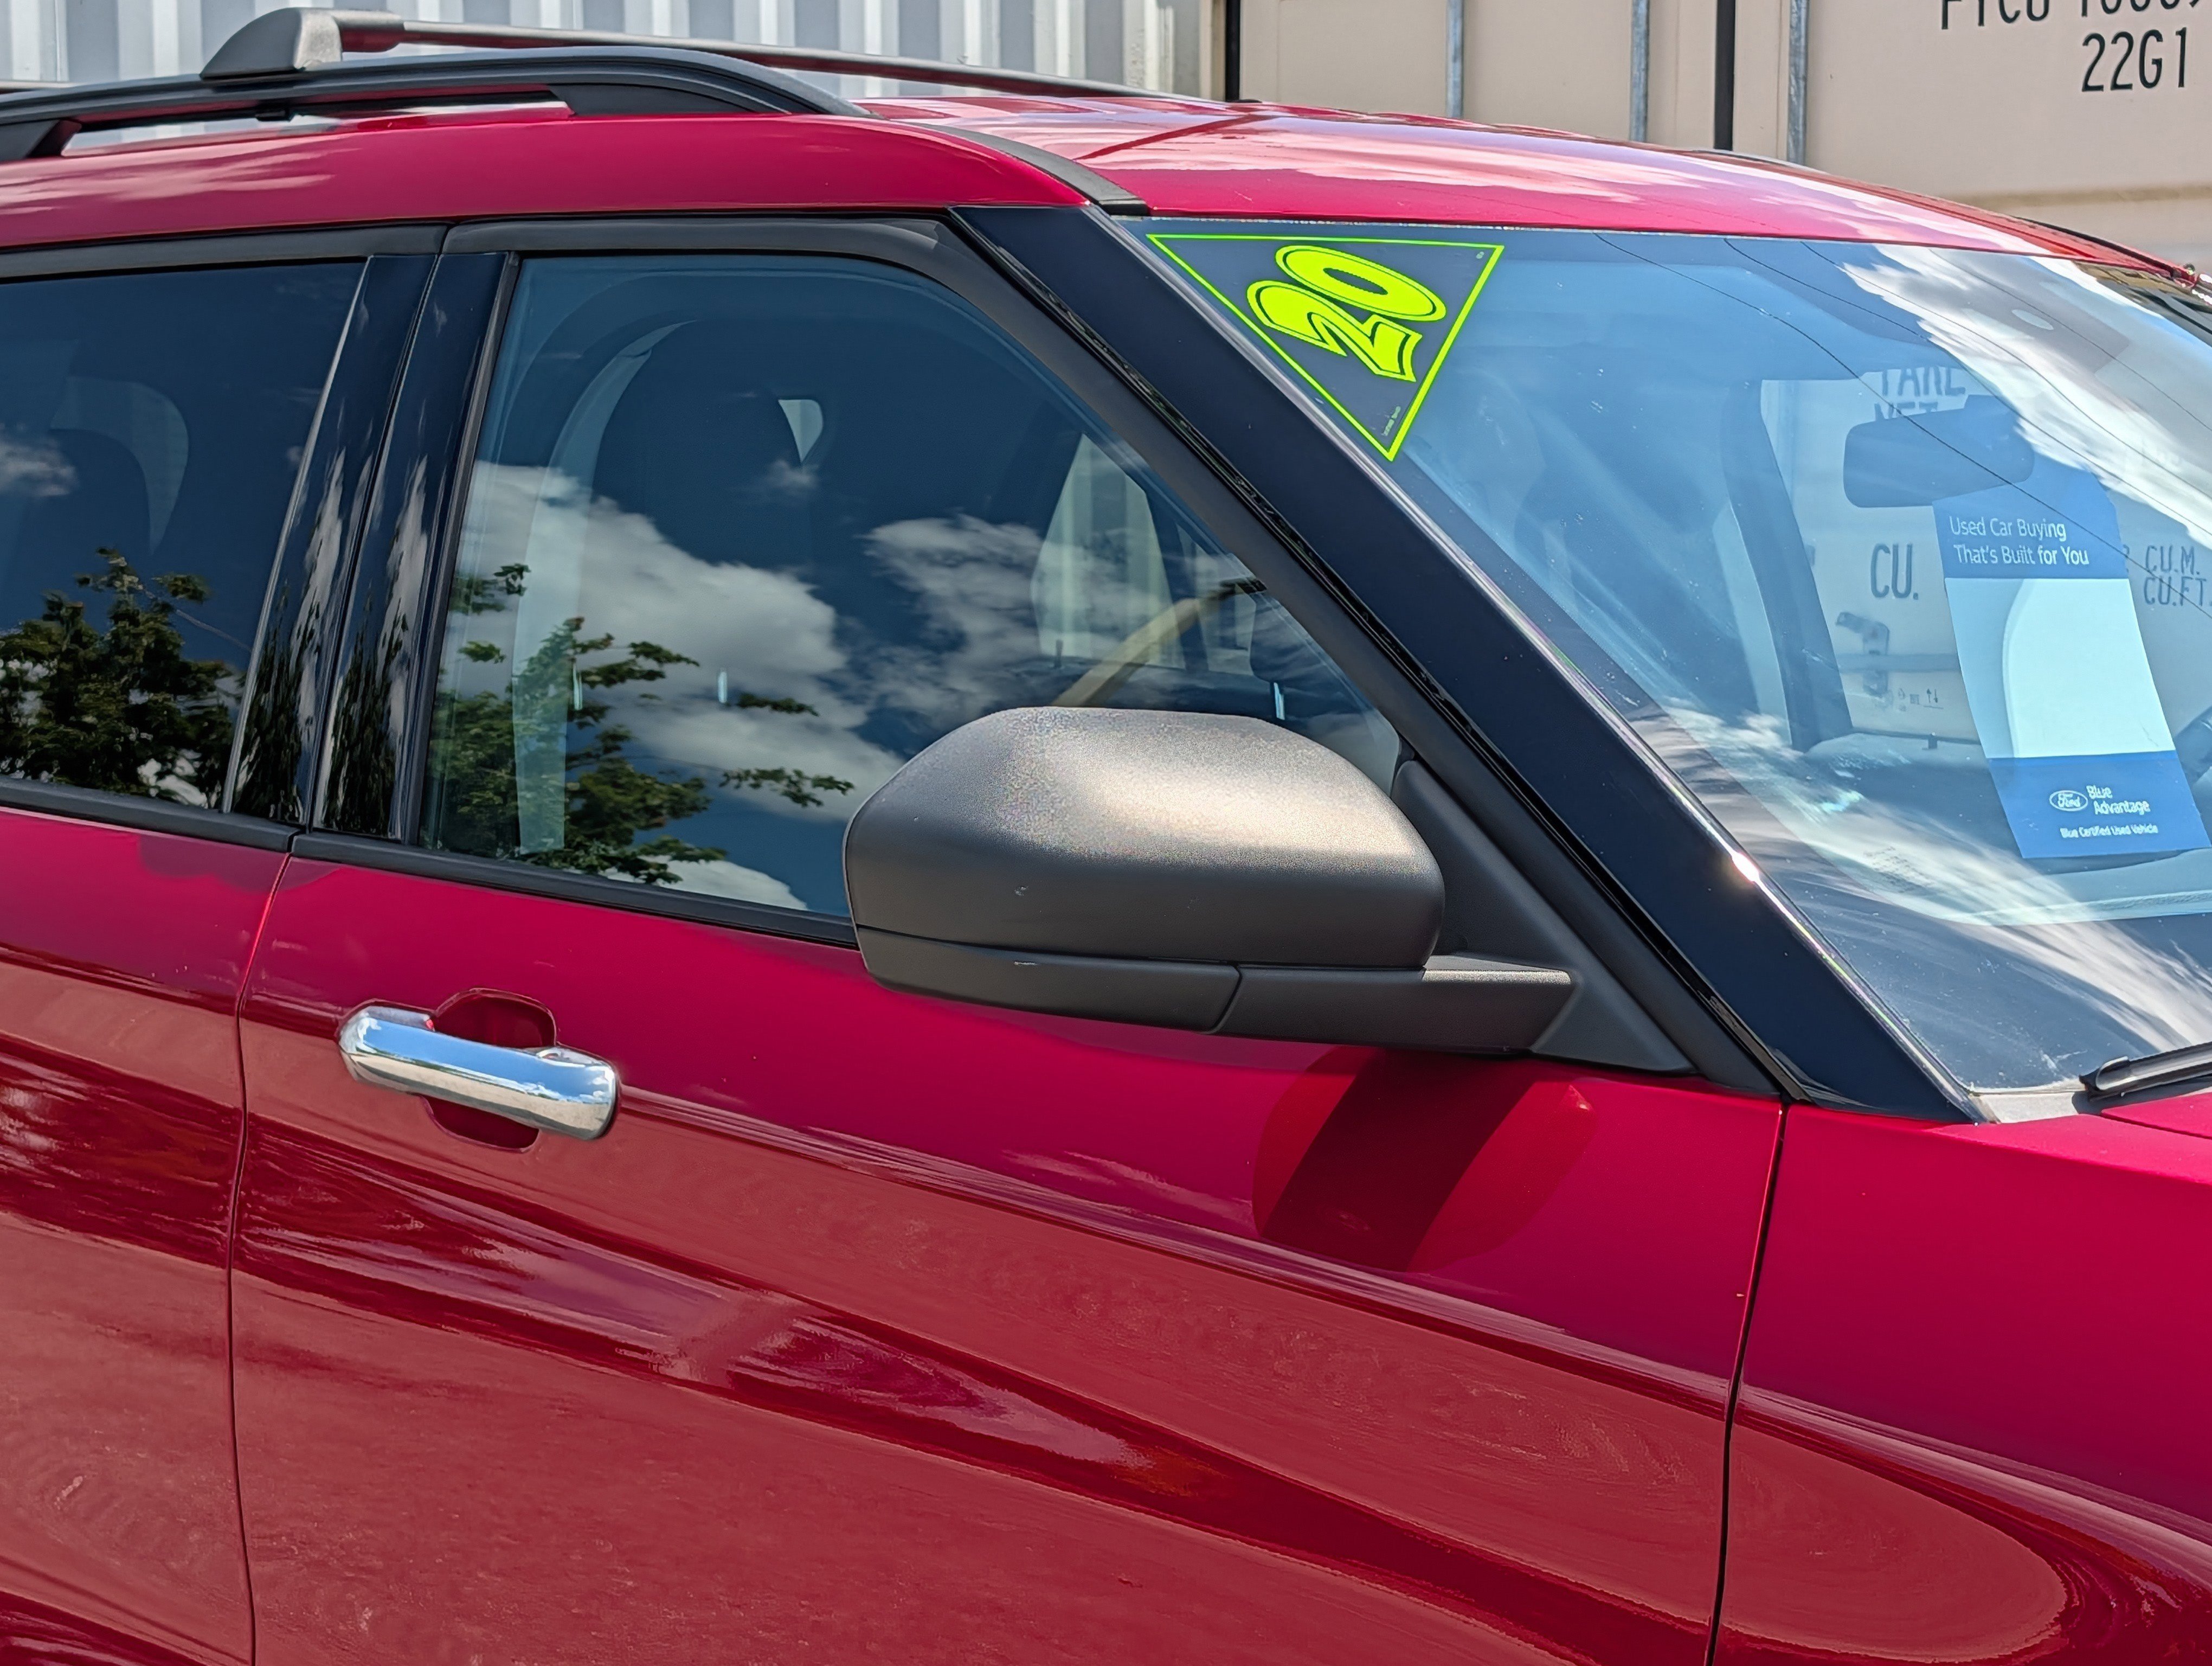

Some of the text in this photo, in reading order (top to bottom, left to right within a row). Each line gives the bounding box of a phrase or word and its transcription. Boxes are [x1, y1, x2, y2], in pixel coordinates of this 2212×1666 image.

[2081, 27, 2188, 92] 22G1
[1246, 245, 1446, 382] 20
[1949, 516, 2067, 542] Used Car Buying
[1953, 544, 2090, 565] That's Built for You
[1870, 543, 1919, 600] CU.
[2086, 785, 2113, 799] Blue
[2093, 800, 2151, 816] Advantage
